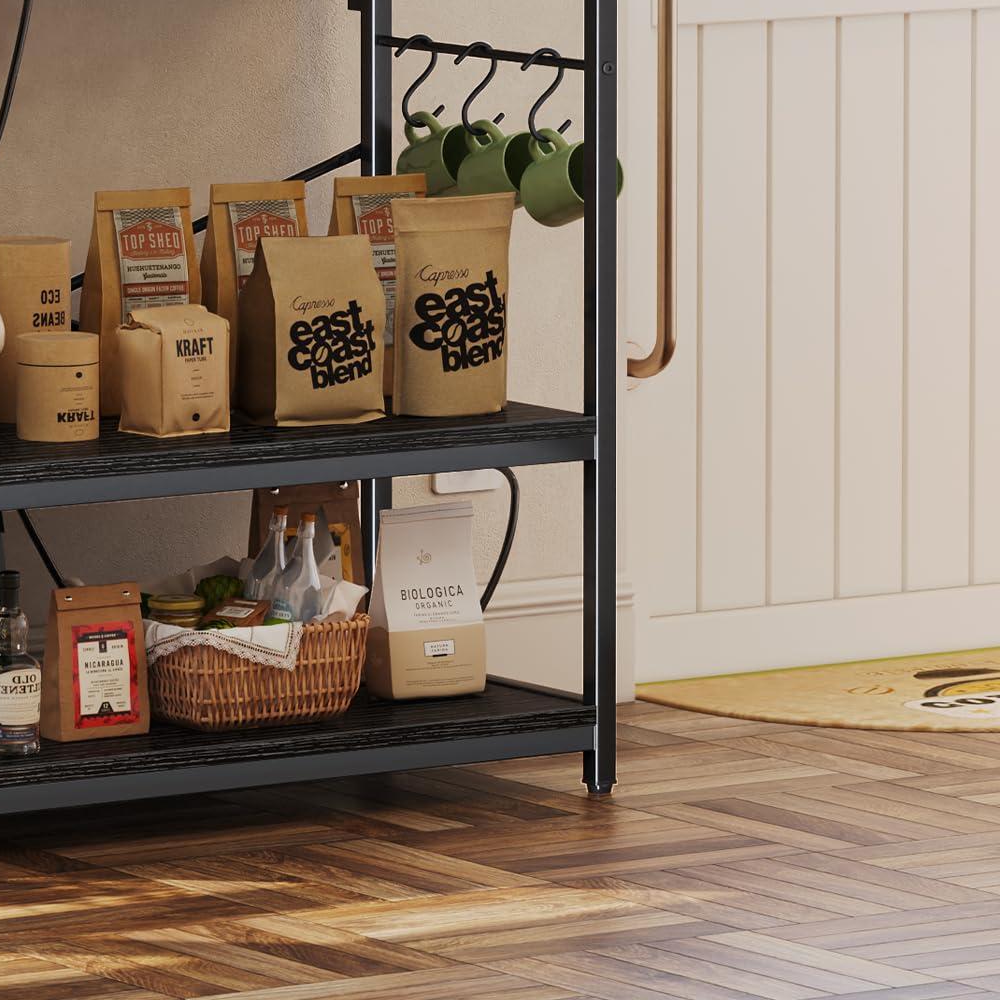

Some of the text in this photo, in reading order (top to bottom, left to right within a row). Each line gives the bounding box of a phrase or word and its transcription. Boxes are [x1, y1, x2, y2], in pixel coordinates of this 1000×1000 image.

[238, 225, 260, 243] TOP
[362, 219, 384, 236] TOP
[123, 232, 180, 252] TOP SHED
[415, 264, 470, 287] Capresso
[290, 296, 335, 315] Capresso
[415, 270, 501, 323] east
[290, 300, 363, 347] east
[176, 336, 214, 357] KRAFT
[287, 320, 376, 371] coast
[310, 350, 372, 389] blend
[400, 584, 465, 601] BIOLOGICA
[415, 600, 454, 610] ORGANIC
[84, 659, 124, 669] NICARAGUA
[920, 694, 1000, 709] CO
